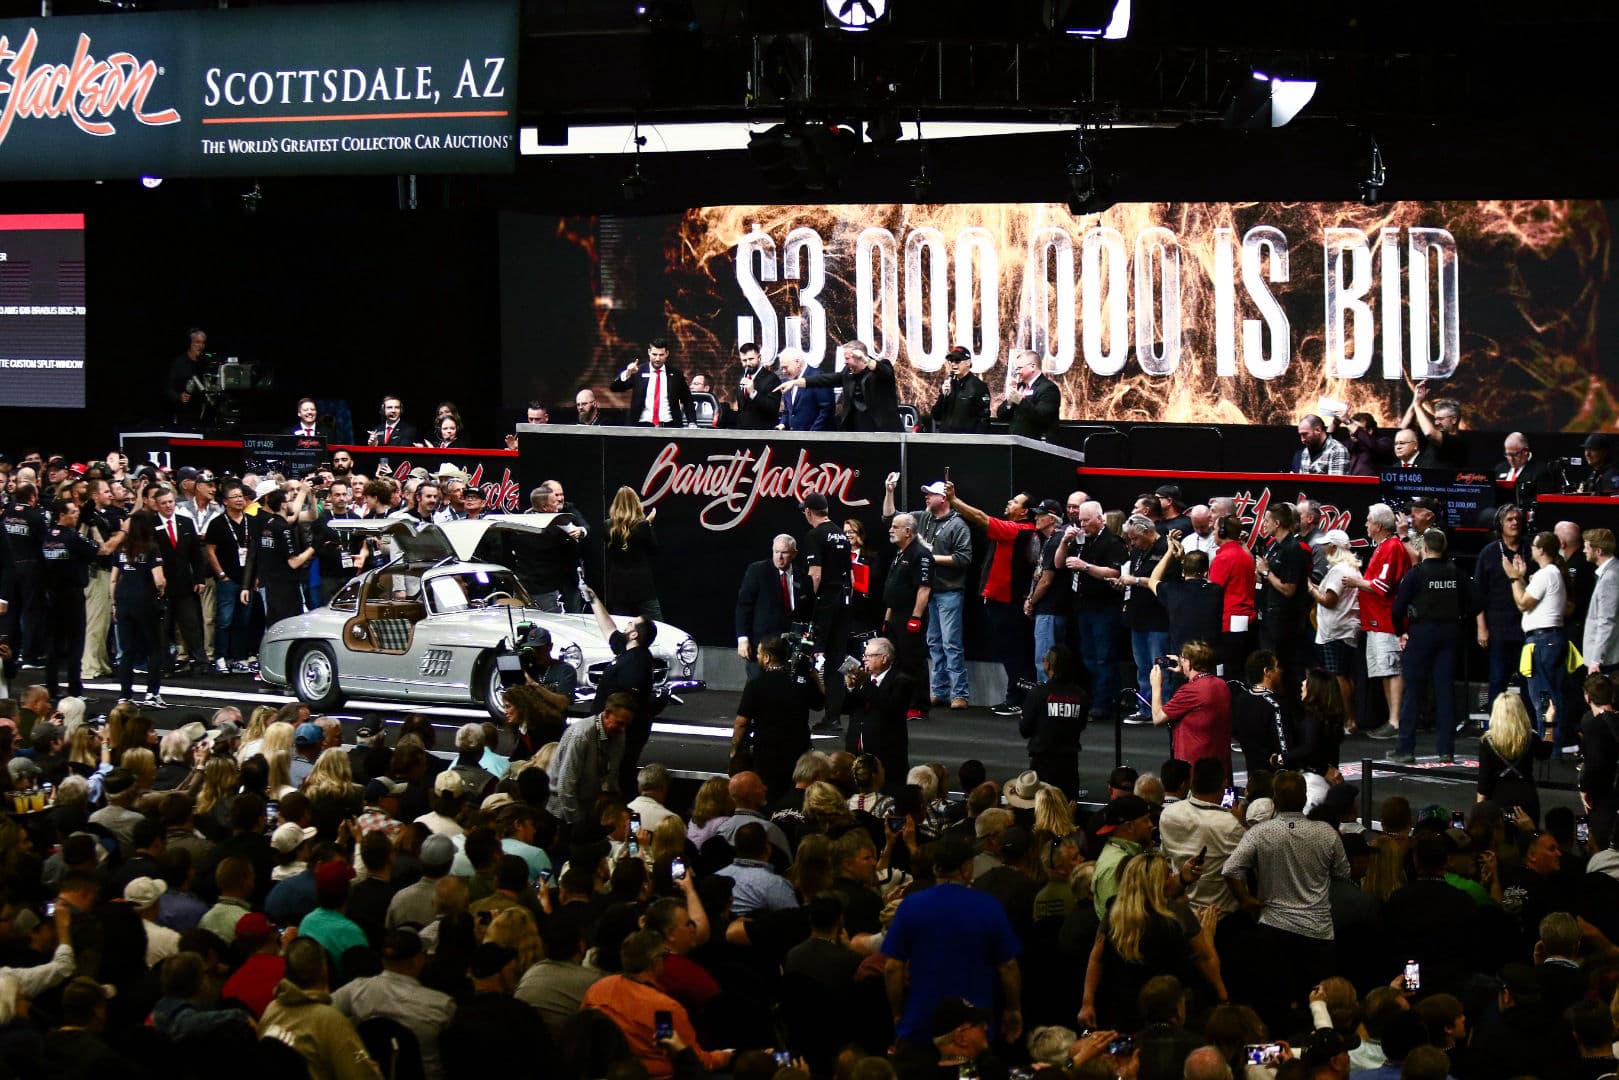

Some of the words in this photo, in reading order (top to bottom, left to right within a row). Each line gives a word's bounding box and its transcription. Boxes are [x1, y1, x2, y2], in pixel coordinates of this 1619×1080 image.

[204, 66, 440, 106] SCOTTSDALE,
[454, 57, 506, 98] AZ
[201, 139, 225, 154] THE
[227, 137, 279, 153] WORLD'S
[281, 138, 340, 152] GREATEST
[341, 135, 412, 151] COLLECTOR
[415, 134, 440, 149] CAR
[1214, 226, 1291, 380] IS
[1324, 226, 1460, 380] BID
[10, 359, 37, 368] CUSTOM
[244, 440, 256, 448] LOT
[1381, 473, 1397, 482] LOT
[1428, 580, 1457, 589] POLICE
[1047, 702, 1081, 718] MEDIA
